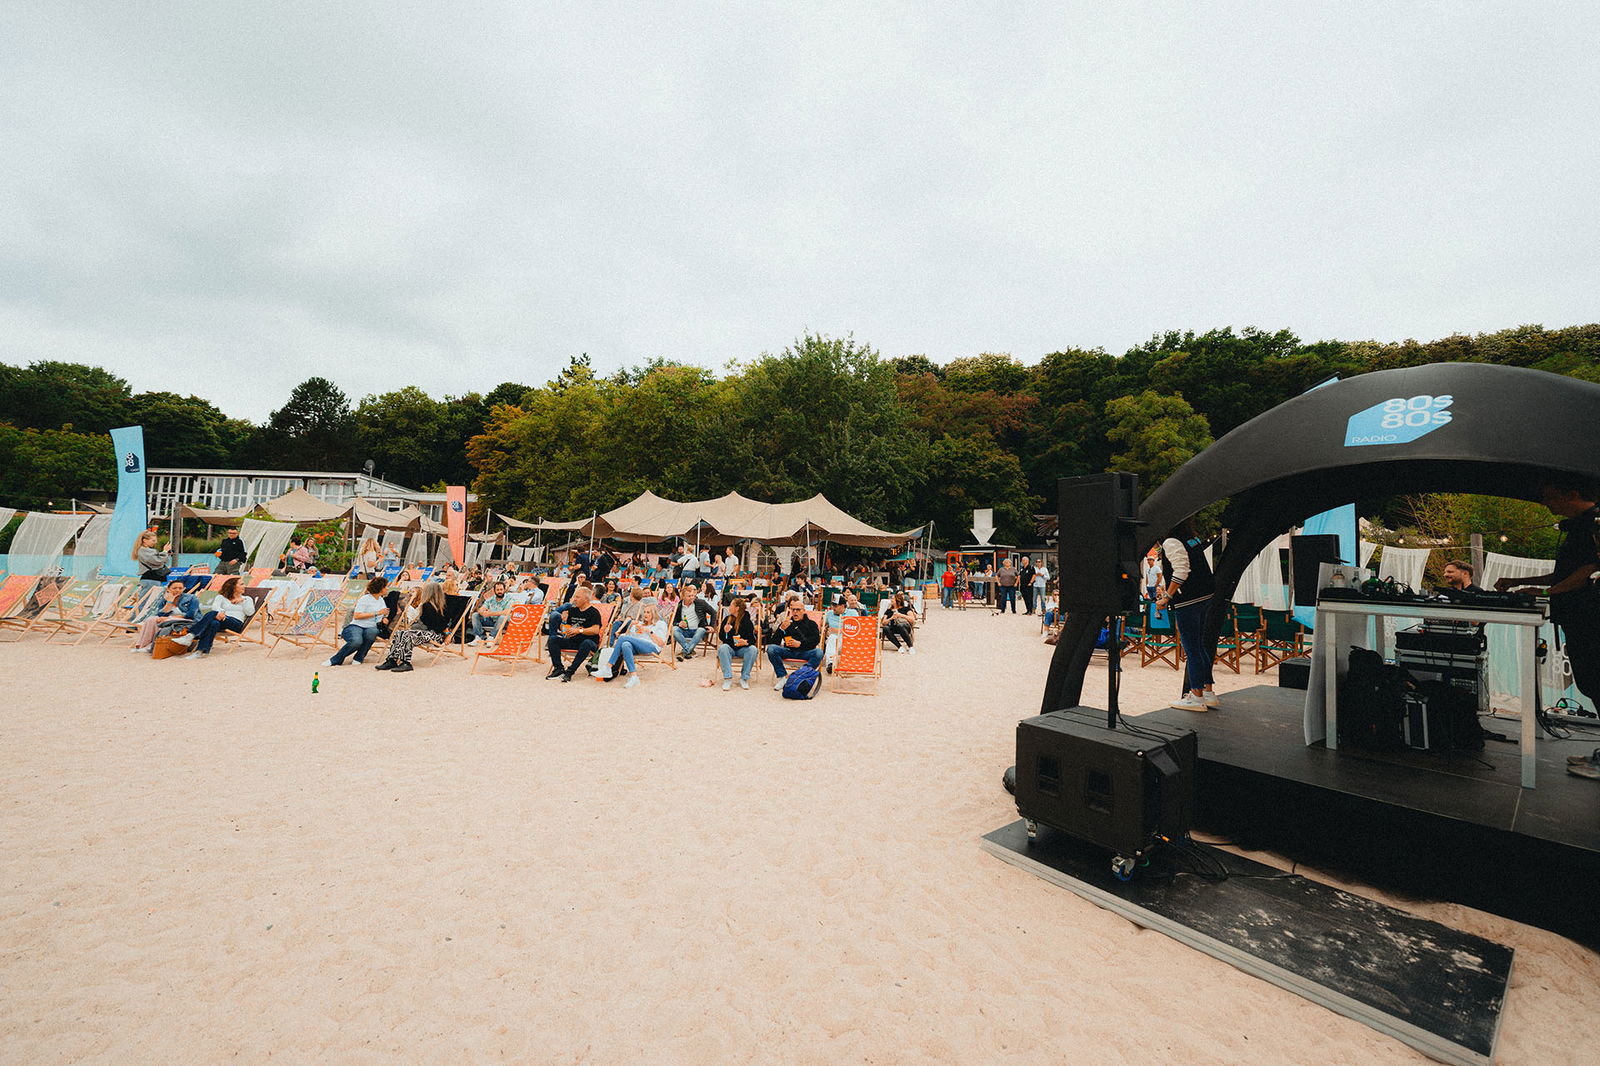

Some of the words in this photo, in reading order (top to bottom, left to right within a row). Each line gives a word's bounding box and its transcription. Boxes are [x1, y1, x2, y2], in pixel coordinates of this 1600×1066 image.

[1384, 395, 1454, 413] 80s
[1381, 411, 1453, 429] 80s
[1352, 434, 1398, 443] RADIO
